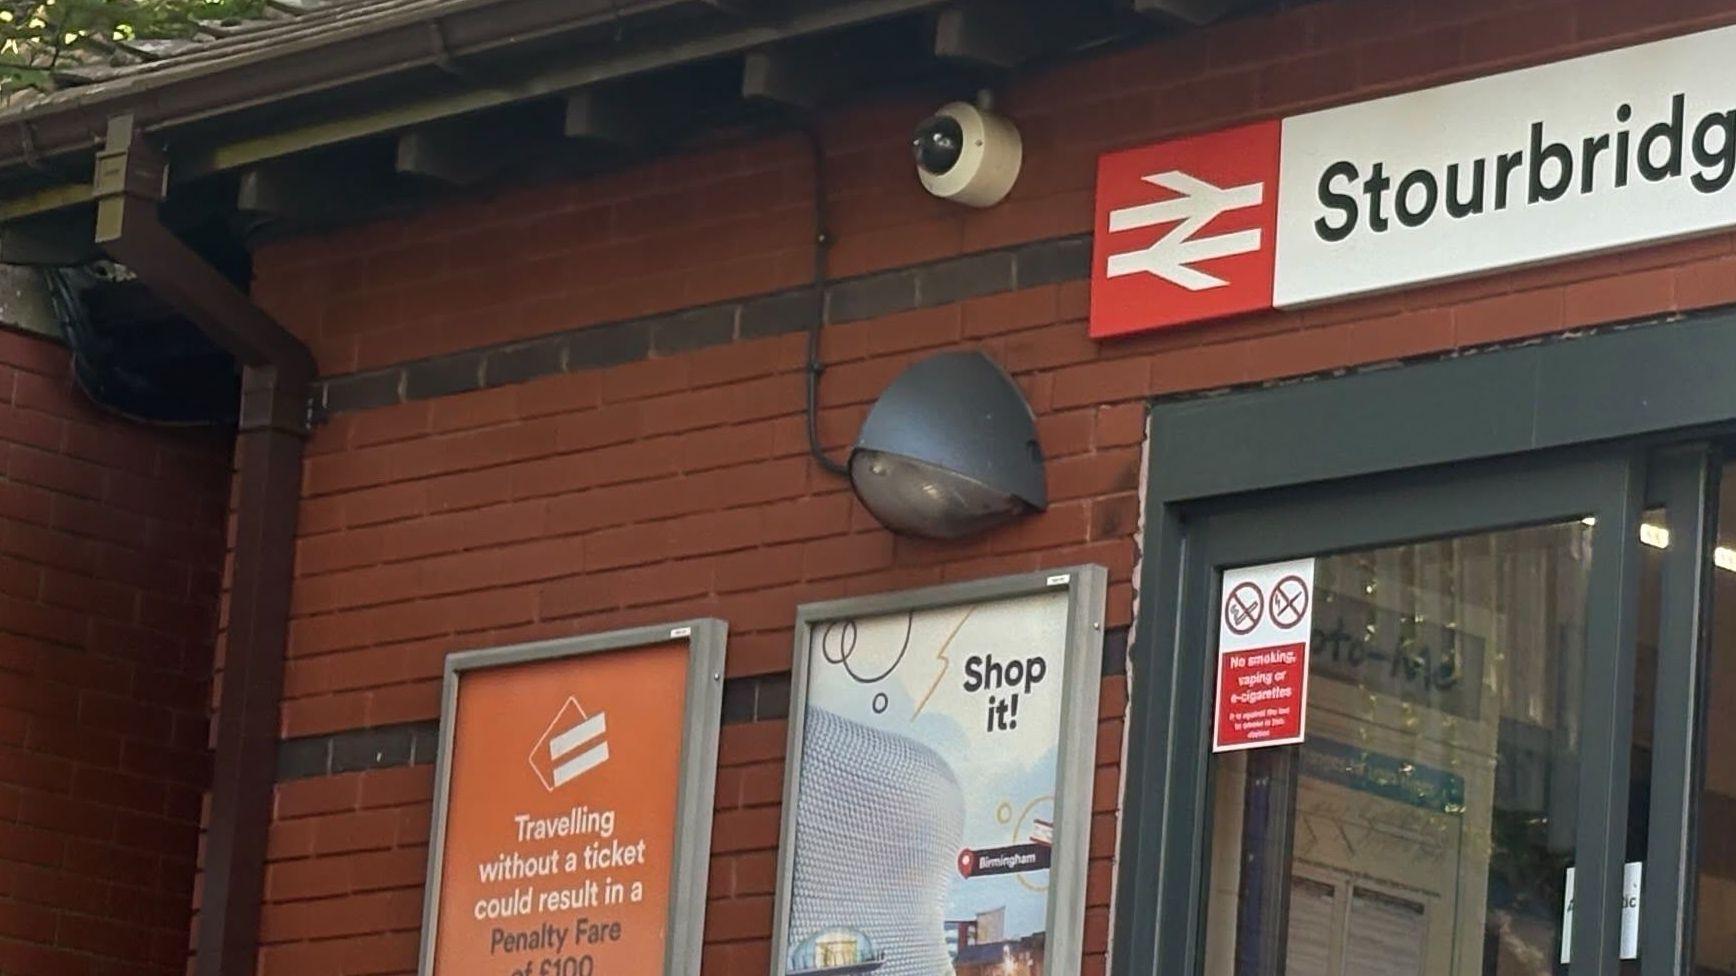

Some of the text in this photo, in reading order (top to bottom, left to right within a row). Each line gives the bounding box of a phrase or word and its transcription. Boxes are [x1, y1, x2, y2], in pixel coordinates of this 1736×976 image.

[963, 654, 1046, 693] Shop
[1230, 651, 1296, 669] No smoking,
[1230, 686, 1292, 704] e-cigarettes
[1238, 671, 1287, 687] vaping or
[987, 694, 1019, 732] it!
[515, 806, 615, 842] Travelling
[479, 839, 645, 883] without a ticket
[979, 851, 1036, 871] Birmingham
[474, 877, 643, 920] could result in a
[490, 918, 621, 955] Penalty Fare
